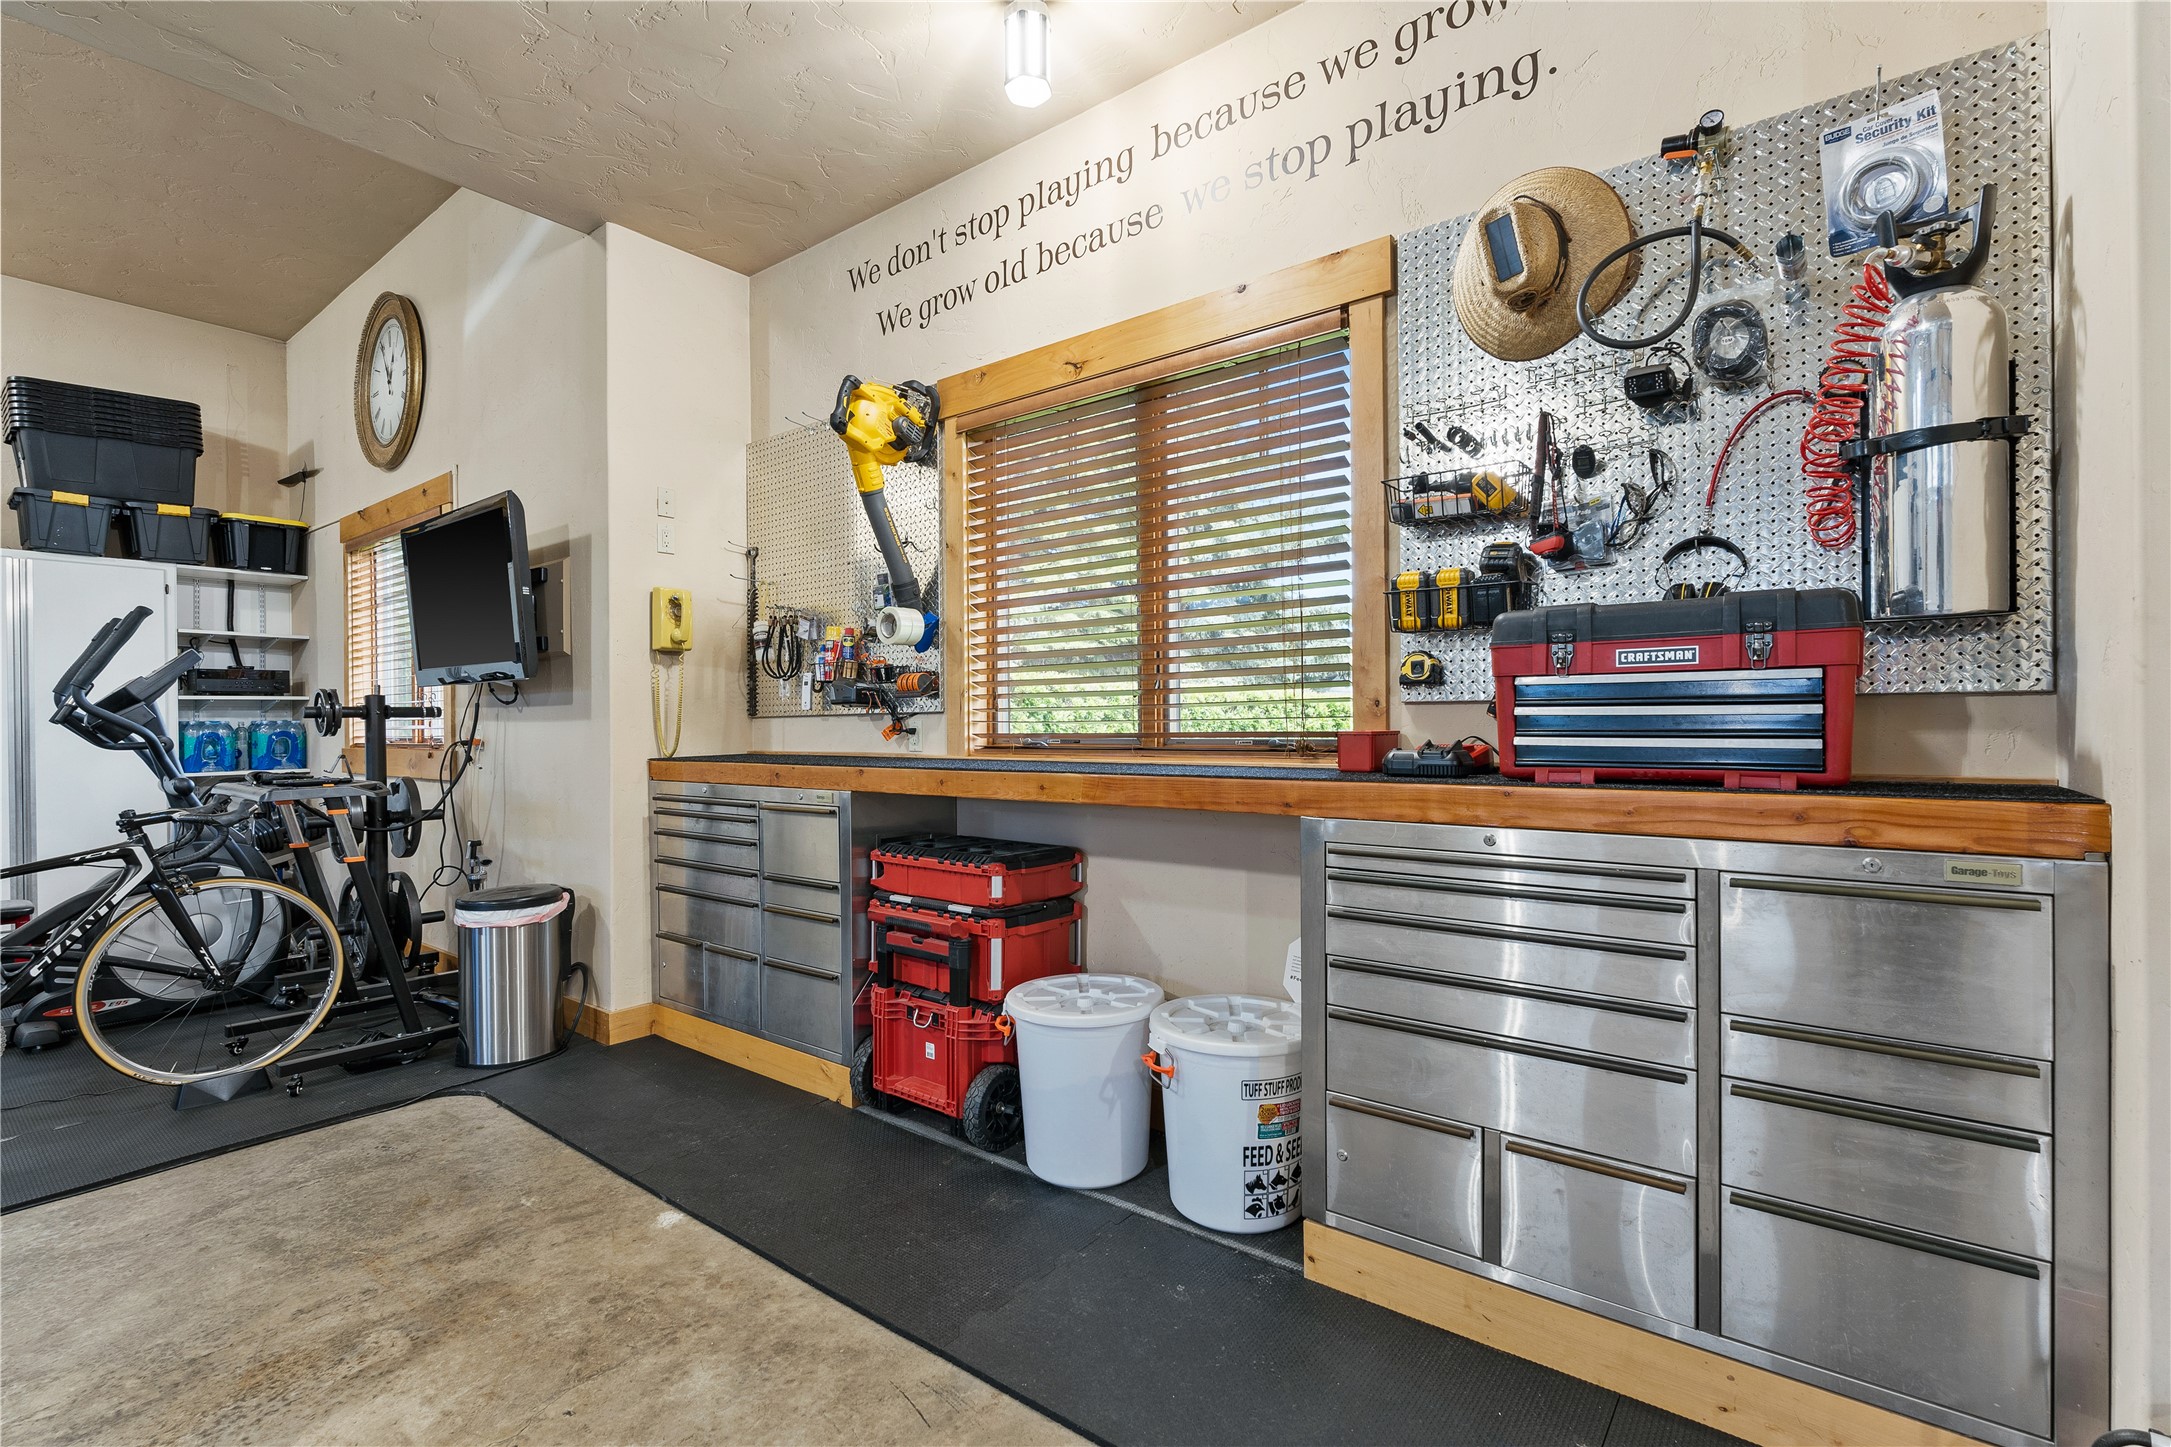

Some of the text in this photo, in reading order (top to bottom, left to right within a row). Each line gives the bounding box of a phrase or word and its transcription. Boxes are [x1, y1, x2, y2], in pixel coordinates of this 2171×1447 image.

[1825, 128, 1851, 142] BUDGE
[1855, 105, 1937, 144] Security Kit
[847, 259, 881, 293] We
[888, 229, 947, 277] don't
[955, 203, 1010, 241] stop
[1018, 146, 1135, 230] playing
[1151, 71, 1306, 160] because
[1317, 39, 1379, 85] we
[876, 48, 1557, 336] We grow old because we stop playing.
[1620, 650, 1693, 662] CRAFTSMAN
[31, 893, 117, 974] GIANT
[1244, 1083, 1262, 1098] TUFF
[1264, 1080, 1285, 1097] STUFF
[1243, 1145, 1273, 1167] FEED
[1275, 1142, 1284, 1165] &
